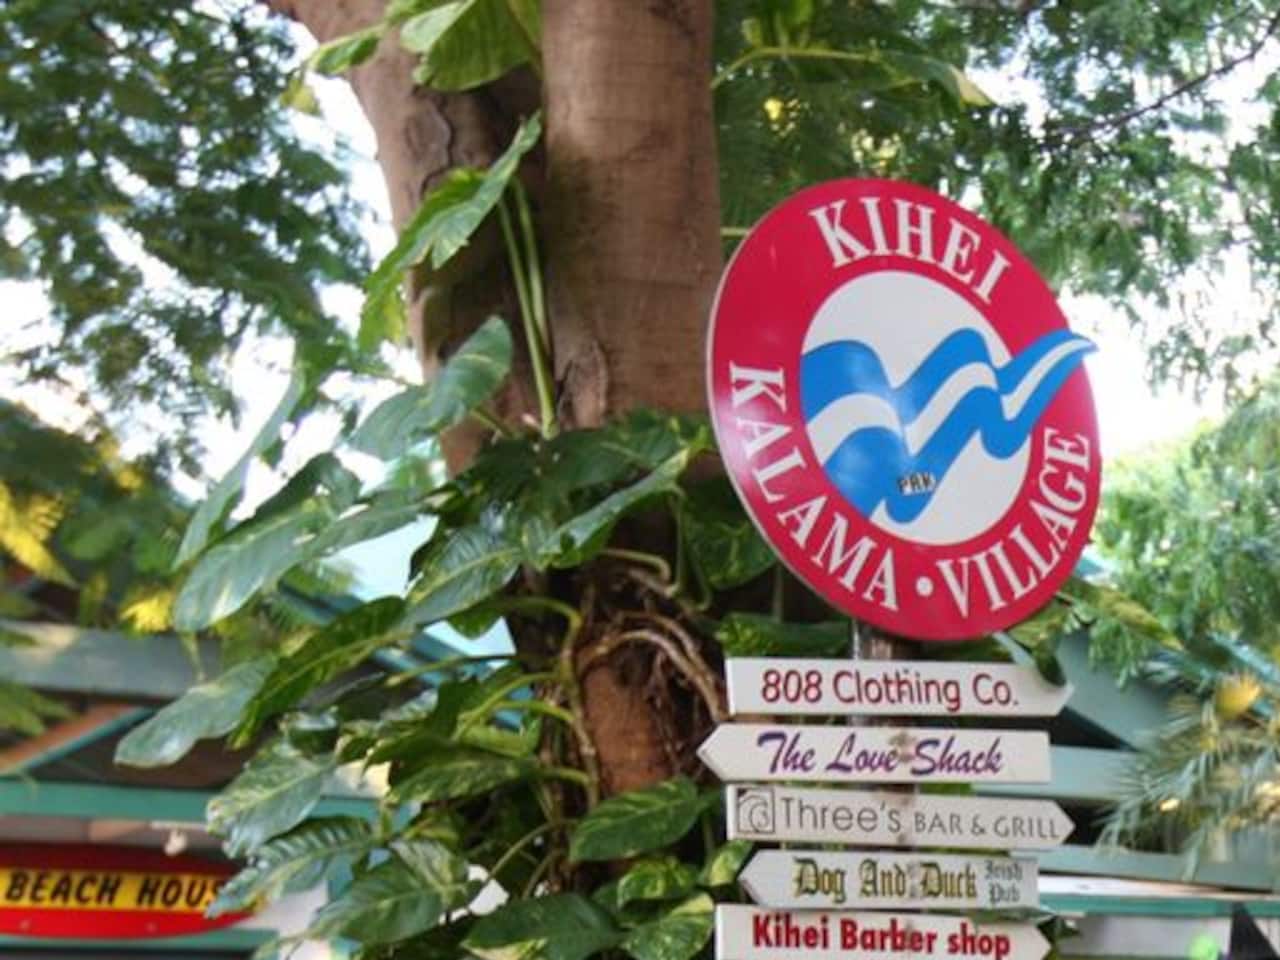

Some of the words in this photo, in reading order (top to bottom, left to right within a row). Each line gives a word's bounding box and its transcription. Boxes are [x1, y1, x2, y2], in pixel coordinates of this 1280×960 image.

[808, 196, 1010, 305] KIHEI
[729, 360, 900, 612] KALAMA
[936, 427, 1091, 619] VILLAGE
[761, 669, 823, 703] 808
[832, 670, 960, 712] Clothing
[972, 673, 1019, 706] Co.
[757, 731, 817, 774] The
[825, 732, 899, 773] Love
[910, 735, 1003, 776] Shack
[781, 797, 902, 833] Three's
[914, 813, 963, 835] BAR
[970, 813, 987, 835] &
[993, 815, 1061, 840] GRILL
[5, 870, 122, 905] BEACH
[137, 875, 222, 907] HOU
[793, 857, 847, 902] Dog
[859, 857, 906, 898] And
[918, 858, 978, 899] Duck
[752, 914, 829, 950] Kihei
[840, 918, 938, 954] Barber
